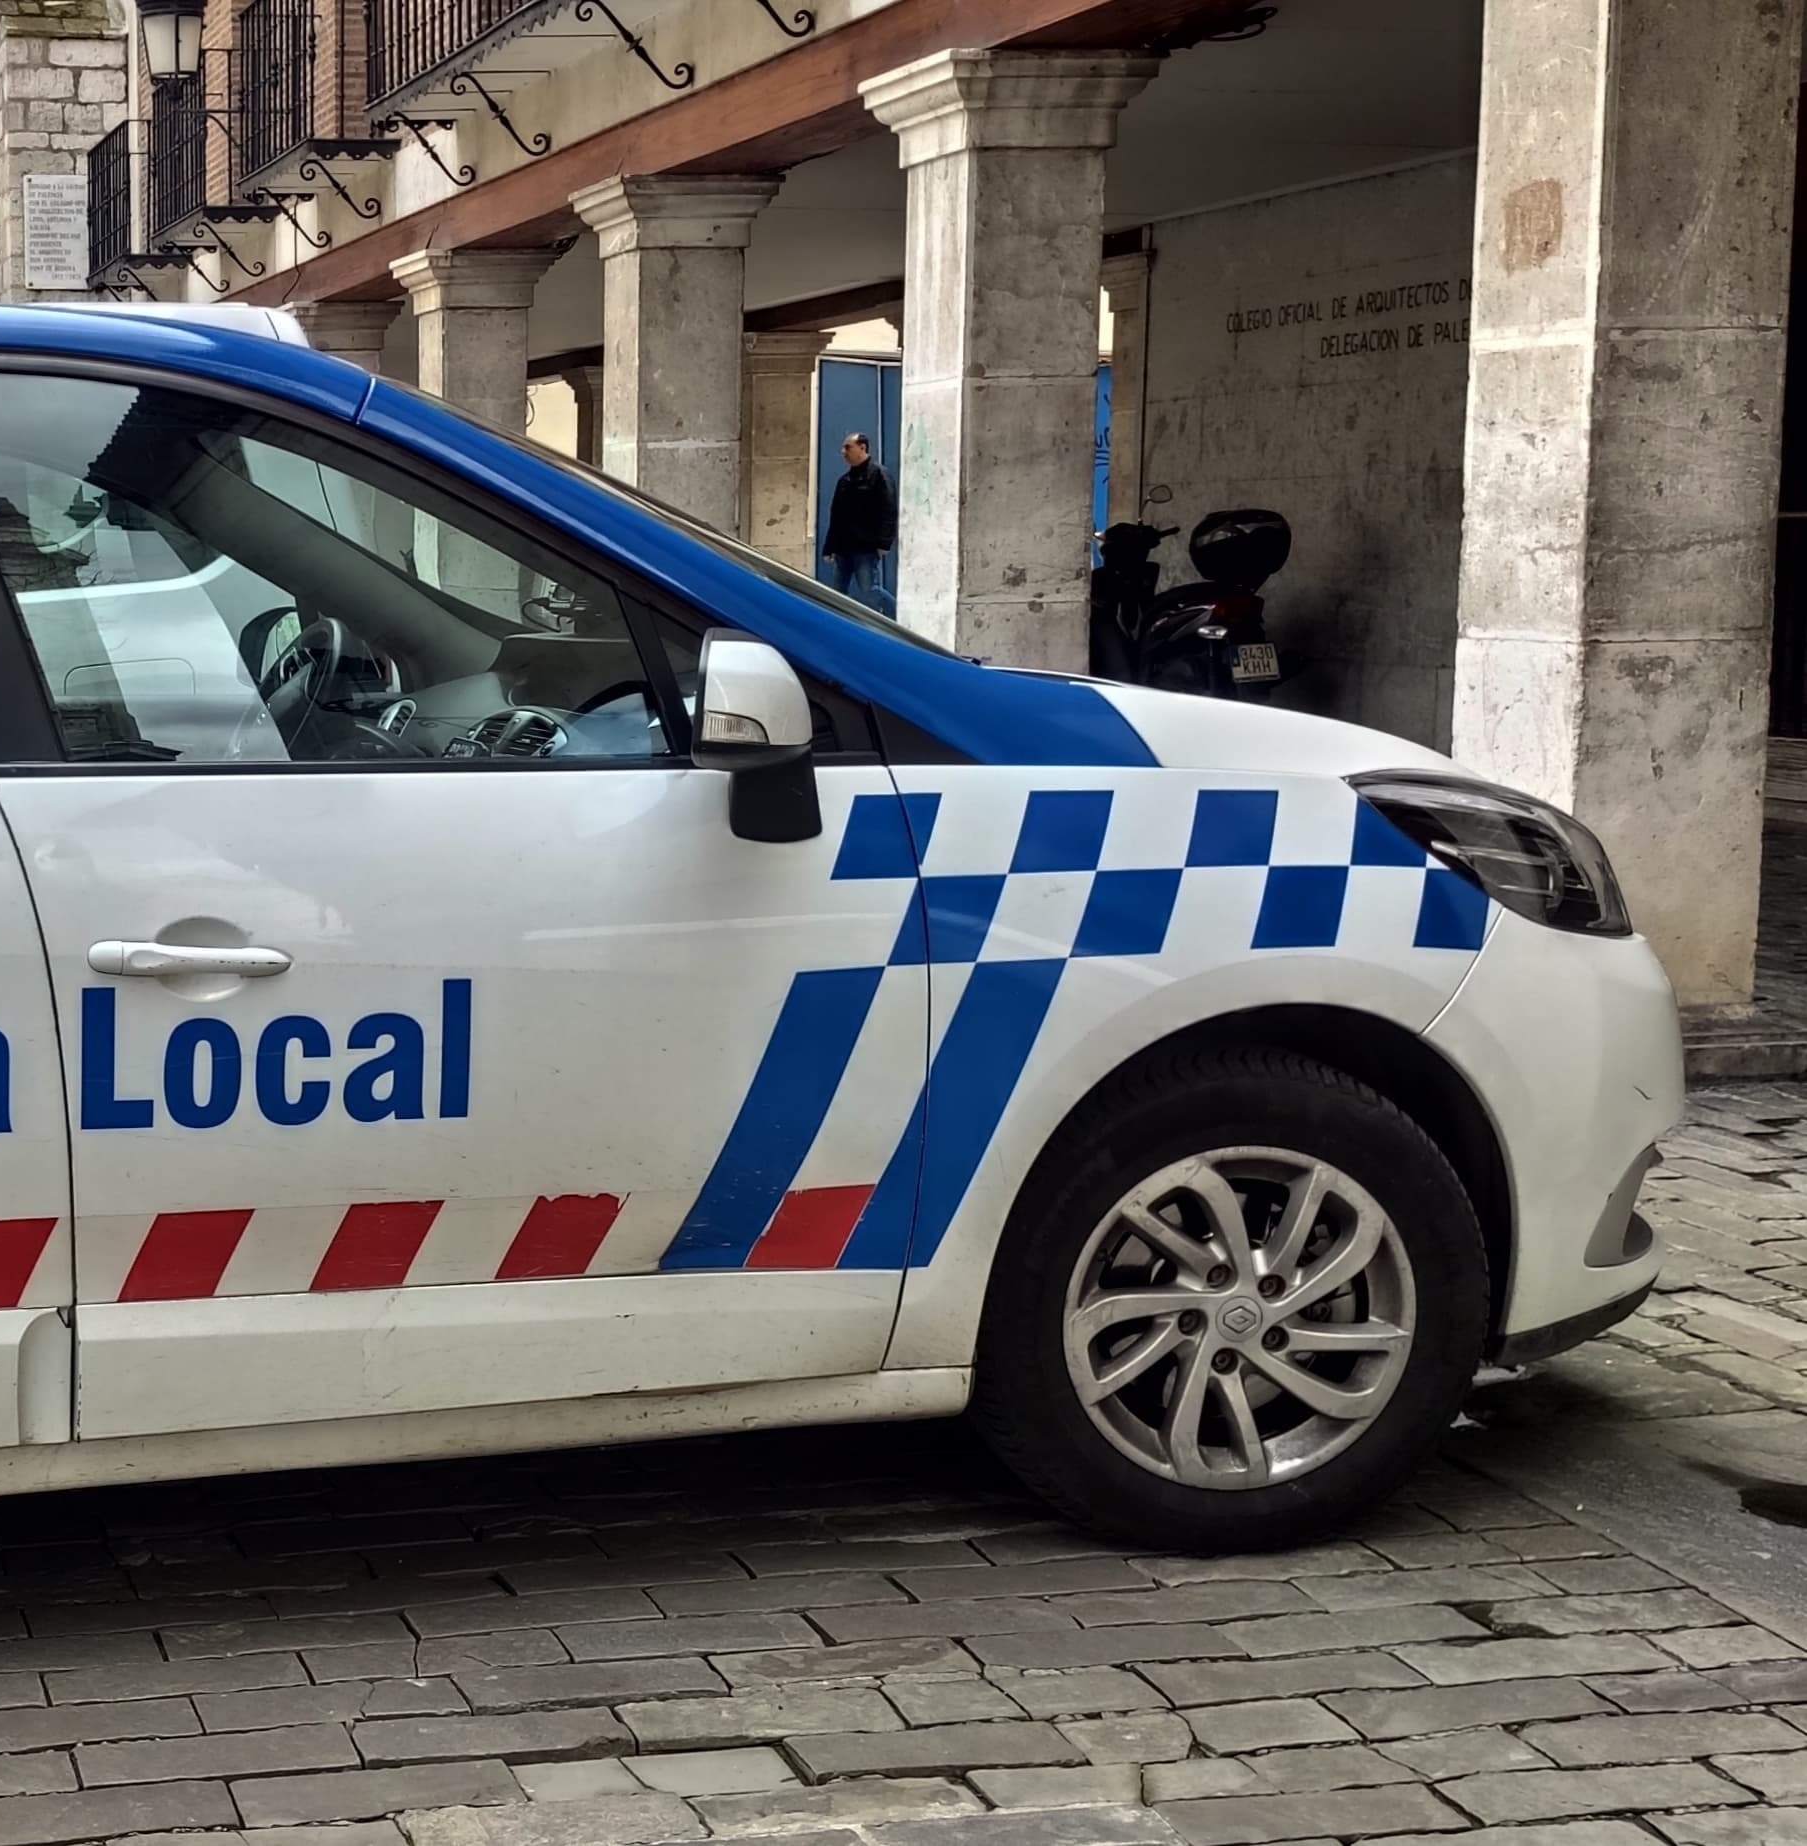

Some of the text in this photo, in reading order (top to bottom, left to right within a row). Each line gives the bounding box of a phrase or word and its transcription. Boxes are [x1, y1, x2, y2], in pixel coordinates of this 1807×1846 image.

[1226, 308, 1272, 334] COLEGIO
[1278, 301, 1323, 326] OFICIAL
[1331, 296, 1347, 319] DE
[1355, 280, 1450, 316] ARQUITECTOS
[1320, 329, 1399, 358] DELEGACION
[1407, 323, 1424, 348] DE
[1240, 646, 1274, 660] 3430
[81, 978, 472, 1130] Local
